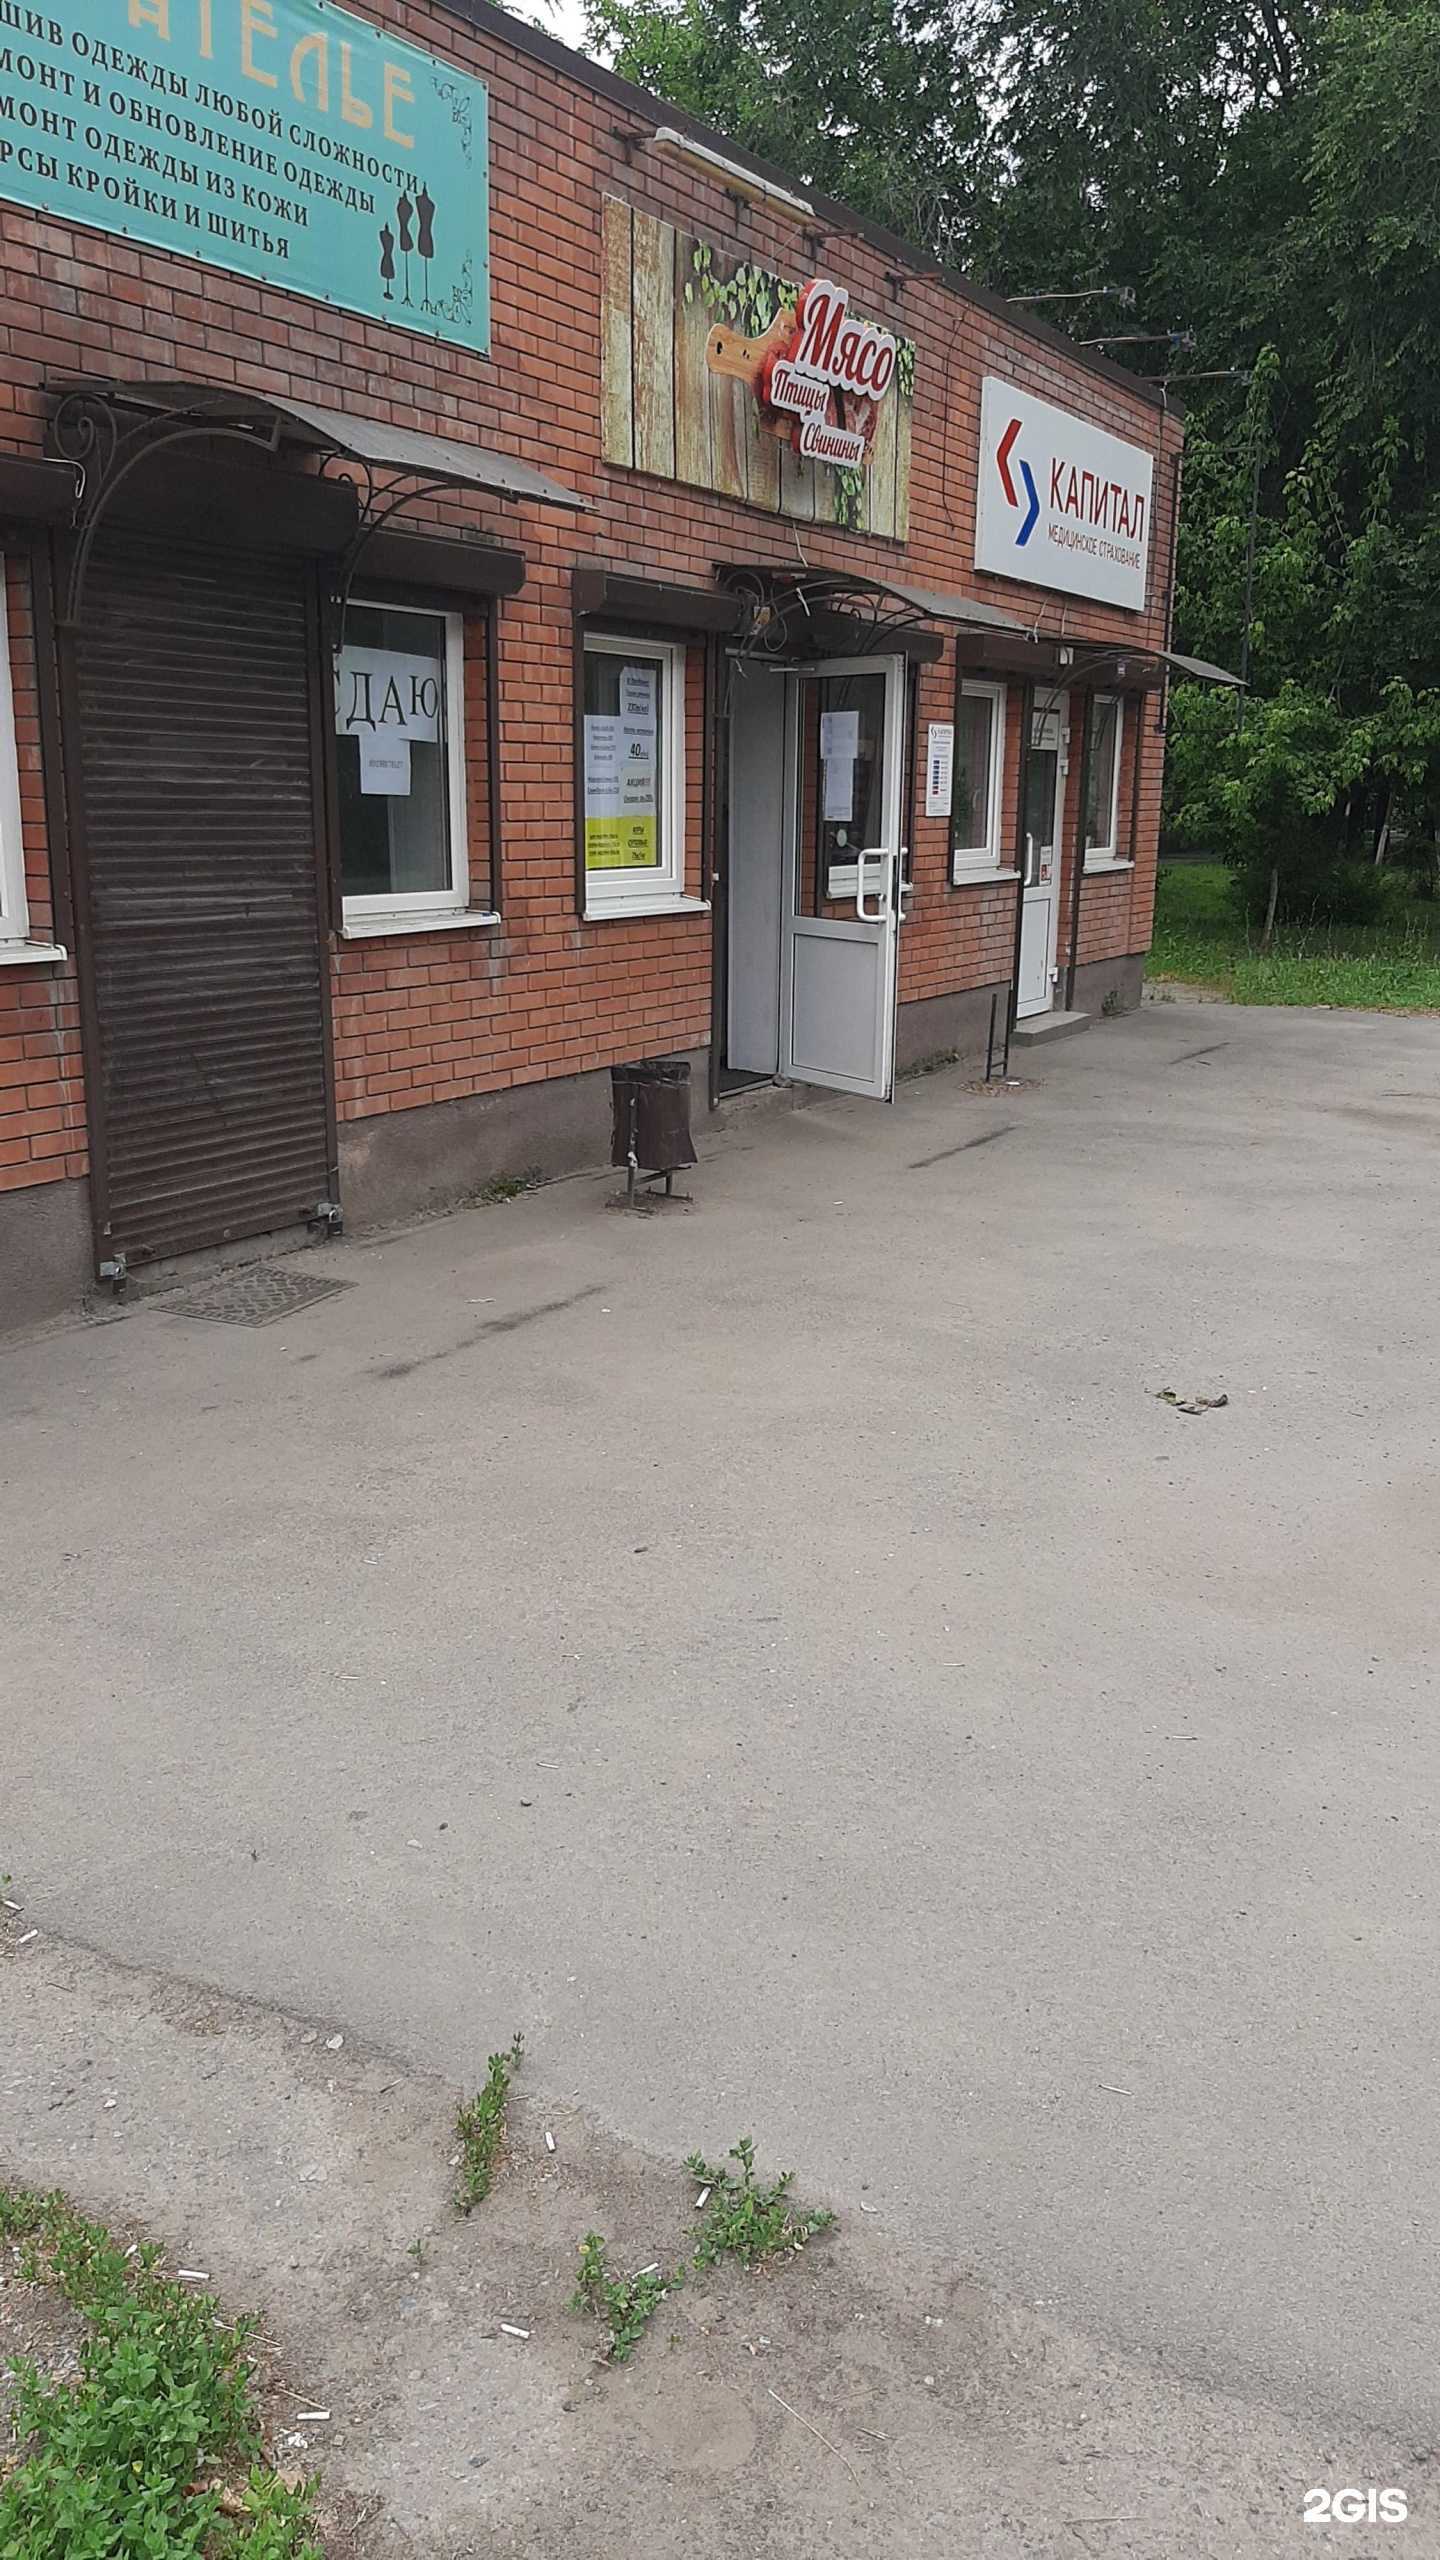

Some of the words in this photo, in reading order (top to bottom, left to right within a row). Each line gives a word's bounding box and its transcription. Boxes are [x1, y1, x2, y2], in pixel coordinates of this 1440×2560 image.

[72, 32, 188, 98] ОДЕЖДЫ
[195, 83, 283, 138] ЛЮБОЙ
[289, 124, 419, 195] СЛОЖНОСТИ
[83, 80, 101, 107] И
[109, 92, 278, 176] ОБНОВЛЕНИЕ
[284, 162, 376, 214] ОДЕЖДЫ
[66, 163, 177, 219] КРОЙКИ
[184, 203, 201, 228] И
[208, 212, 289, 259] ШИТЬЯ
[85, 127, 198, 186] ОДЕЖДЫ
[206, 170, 235, 199] ИЗ
[242, 184, 309, 227] КОЖИ
[774, 369, 828, 413] Птицы
[800, 294, 893, 392] Мясо
[804, 422, 860, 462] Свинины
[1048, 522, 1097, 556] МЕДИЦИНСКОЕ
[1098, 540, 1141, 570] СТРАХОВАНИЕ
[1050, 457, 1145, 542] КАПИТАЛ
